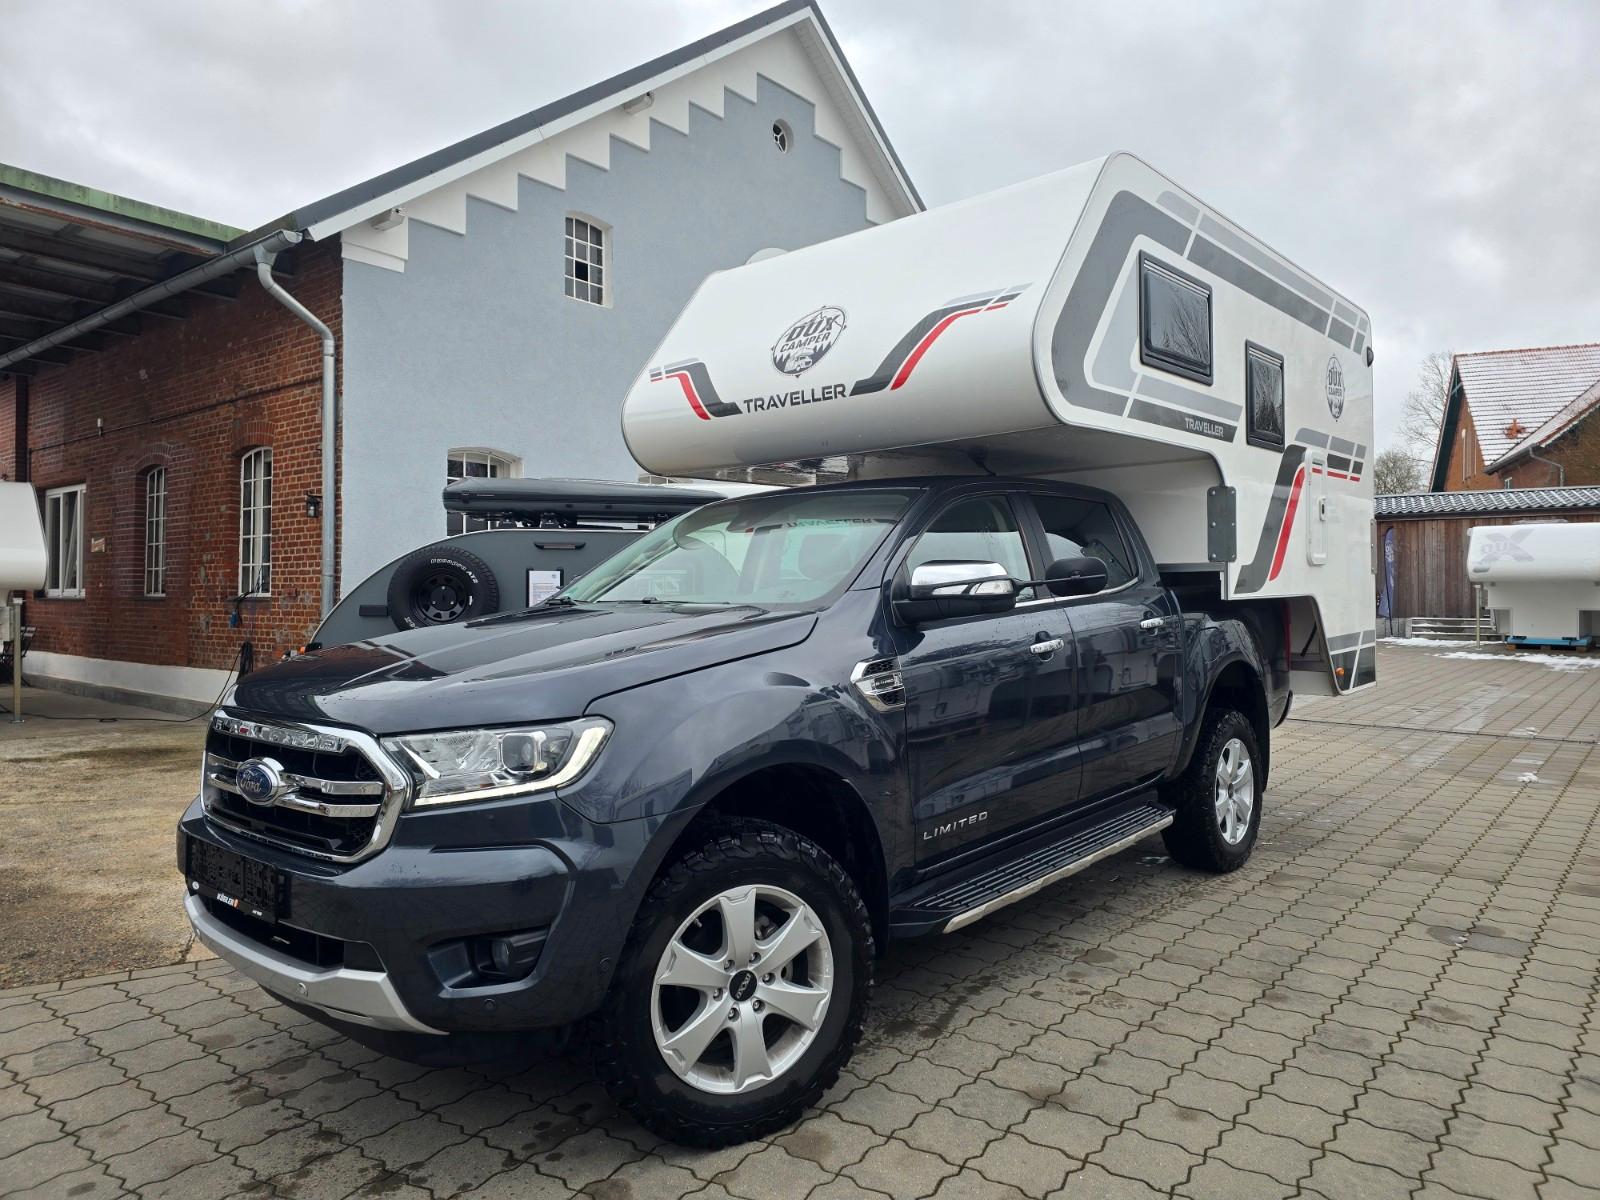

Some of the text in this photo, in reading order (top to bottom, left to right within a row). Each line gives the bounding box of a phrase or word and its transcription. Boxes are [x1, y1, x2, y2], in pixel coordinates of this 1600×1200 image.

[786, 314, 840, 342] DUX
[780, 332, 831, 353] CAMPER
[1328, 369, 1342, 387] DUX
[743, 383, 847, 413] TRAVELLER
[1185, 417, 1224, 438] TRAVELLER
[240, 769, 262, 793] Ford
[923, 811, 988, 840] LIMITED
